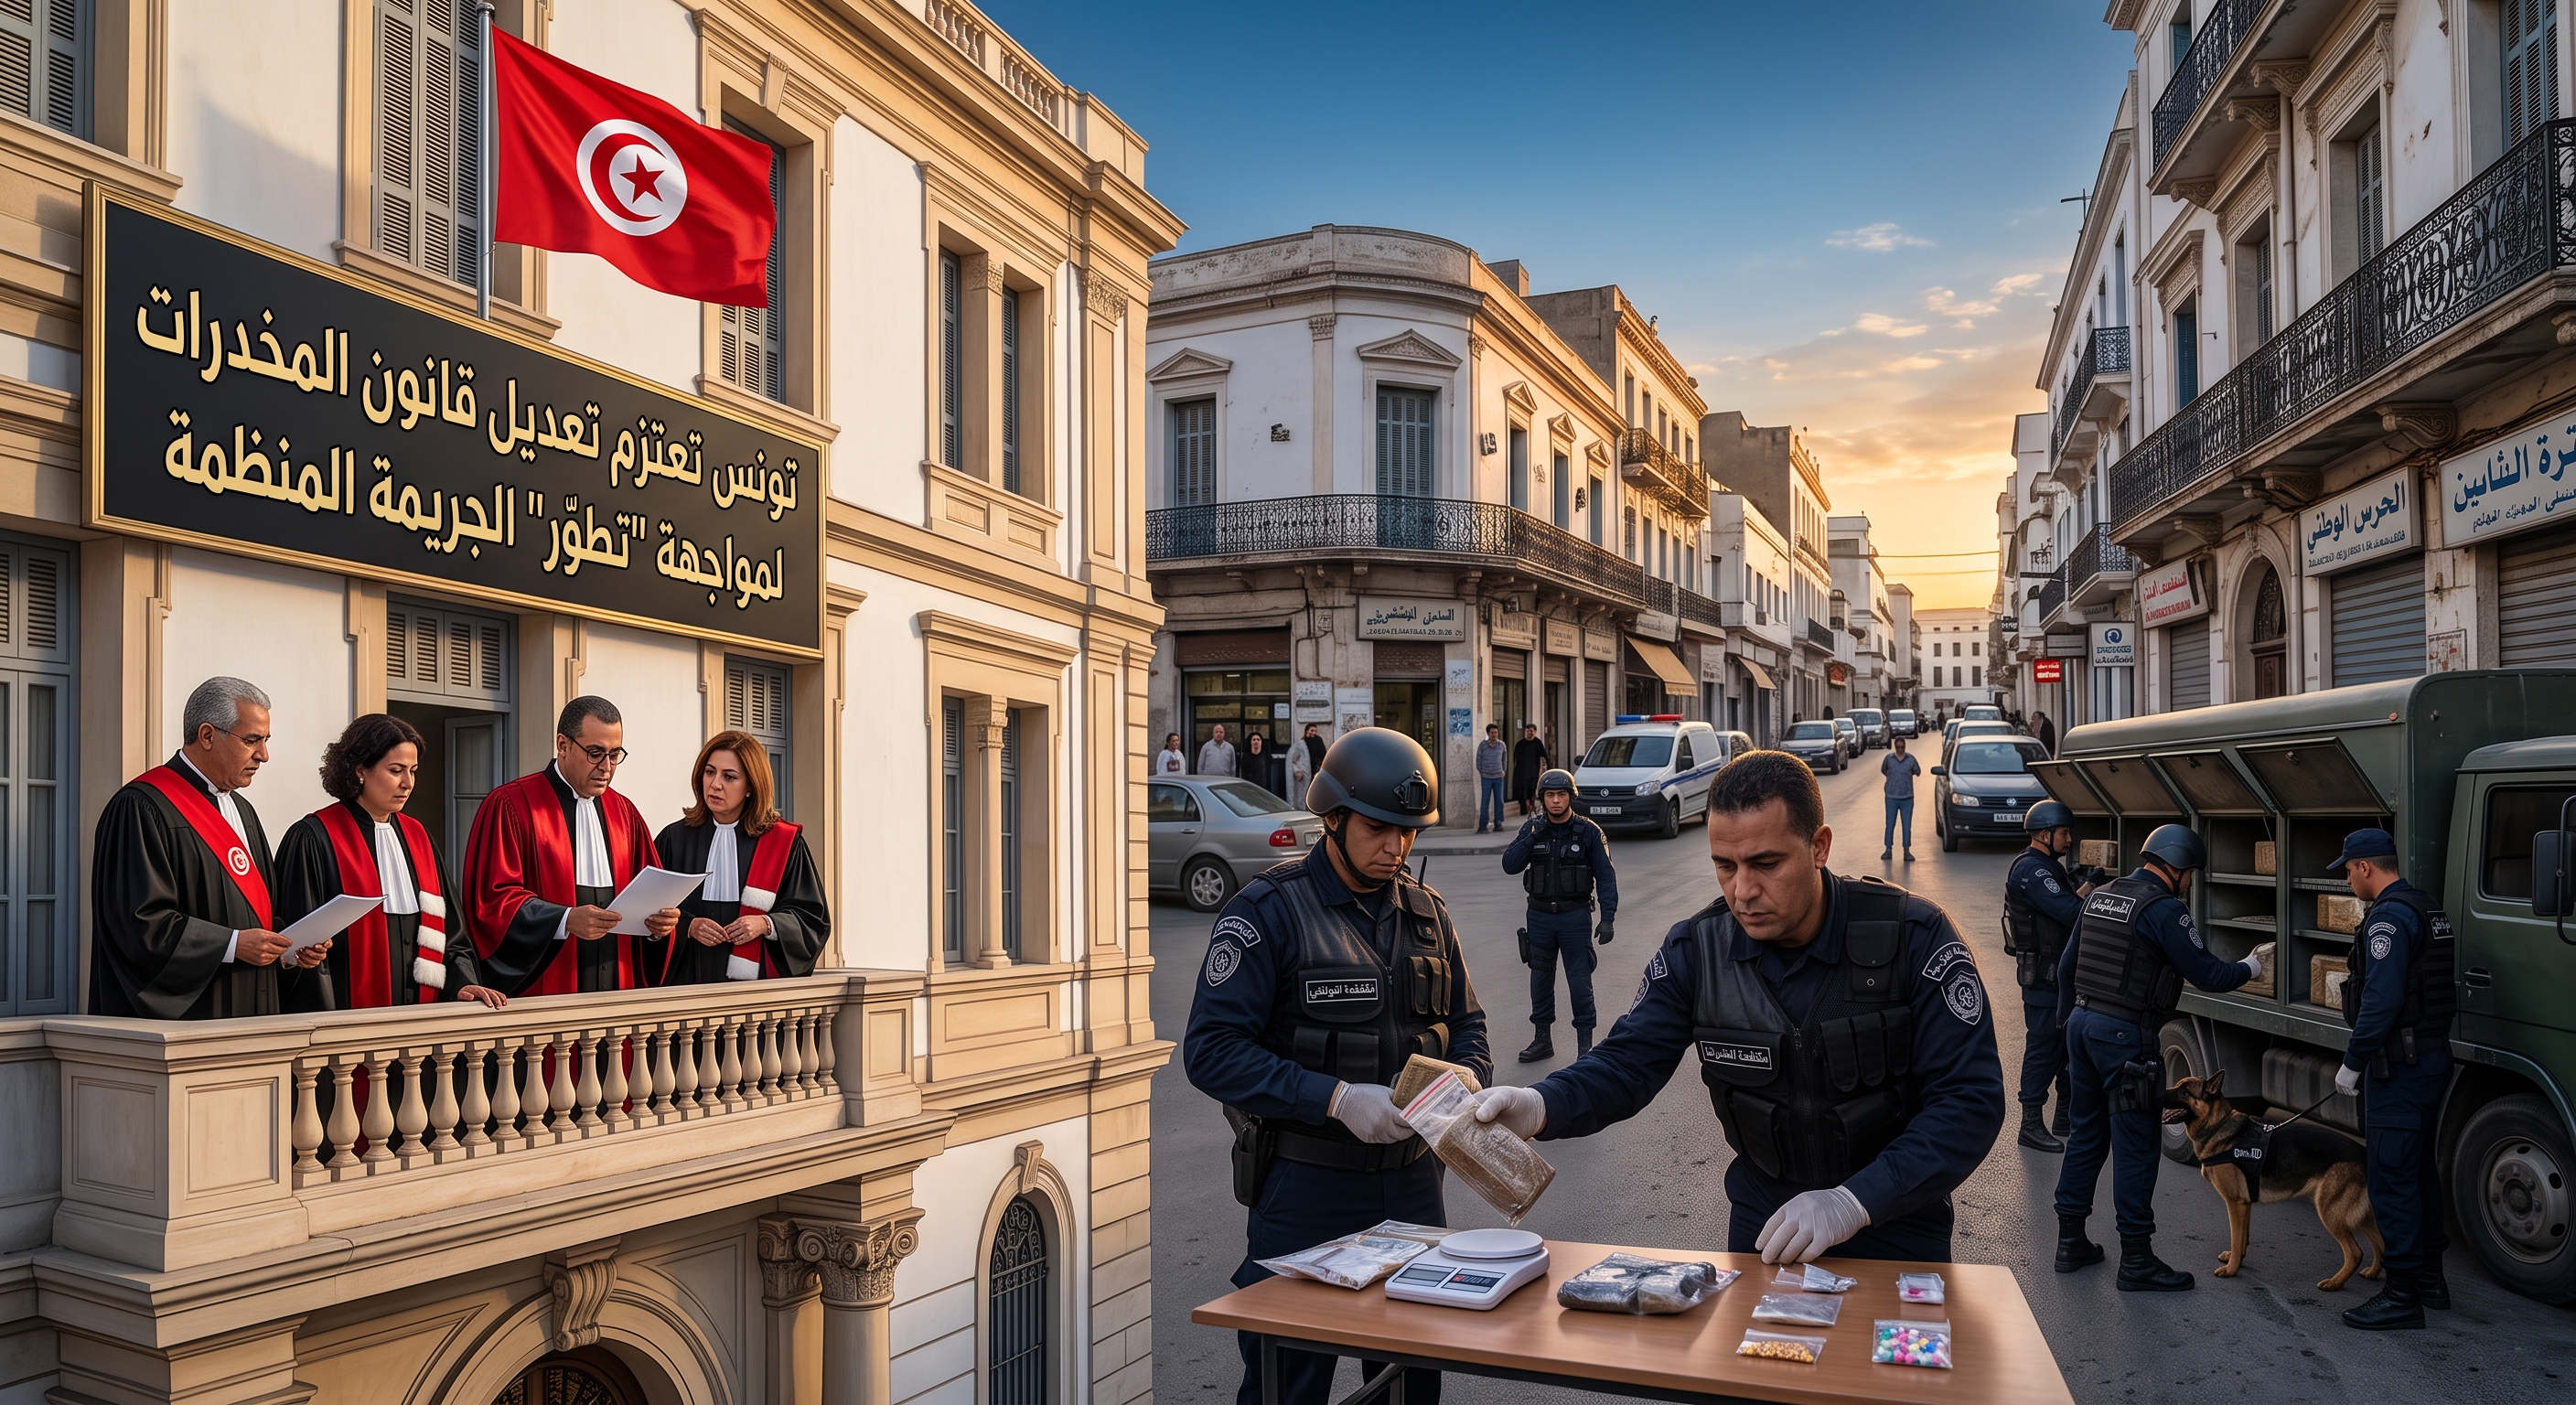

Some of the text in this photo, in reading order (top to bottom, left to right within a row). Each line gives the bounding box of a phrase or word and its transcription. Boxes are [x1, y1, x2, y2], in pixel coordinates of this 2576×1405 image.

[136, 284, 799, 521] تونس تعتزم تعديل قانون المخدرات
[165, 408, 355, 515] المنظمة
[369, 455, 515, 560] الجريمة
[2354, 478, 2406, 534] الحرس
[656, 520, 784, 609] لمواجهة
[2307, 501, 2350, 555] الوطني
